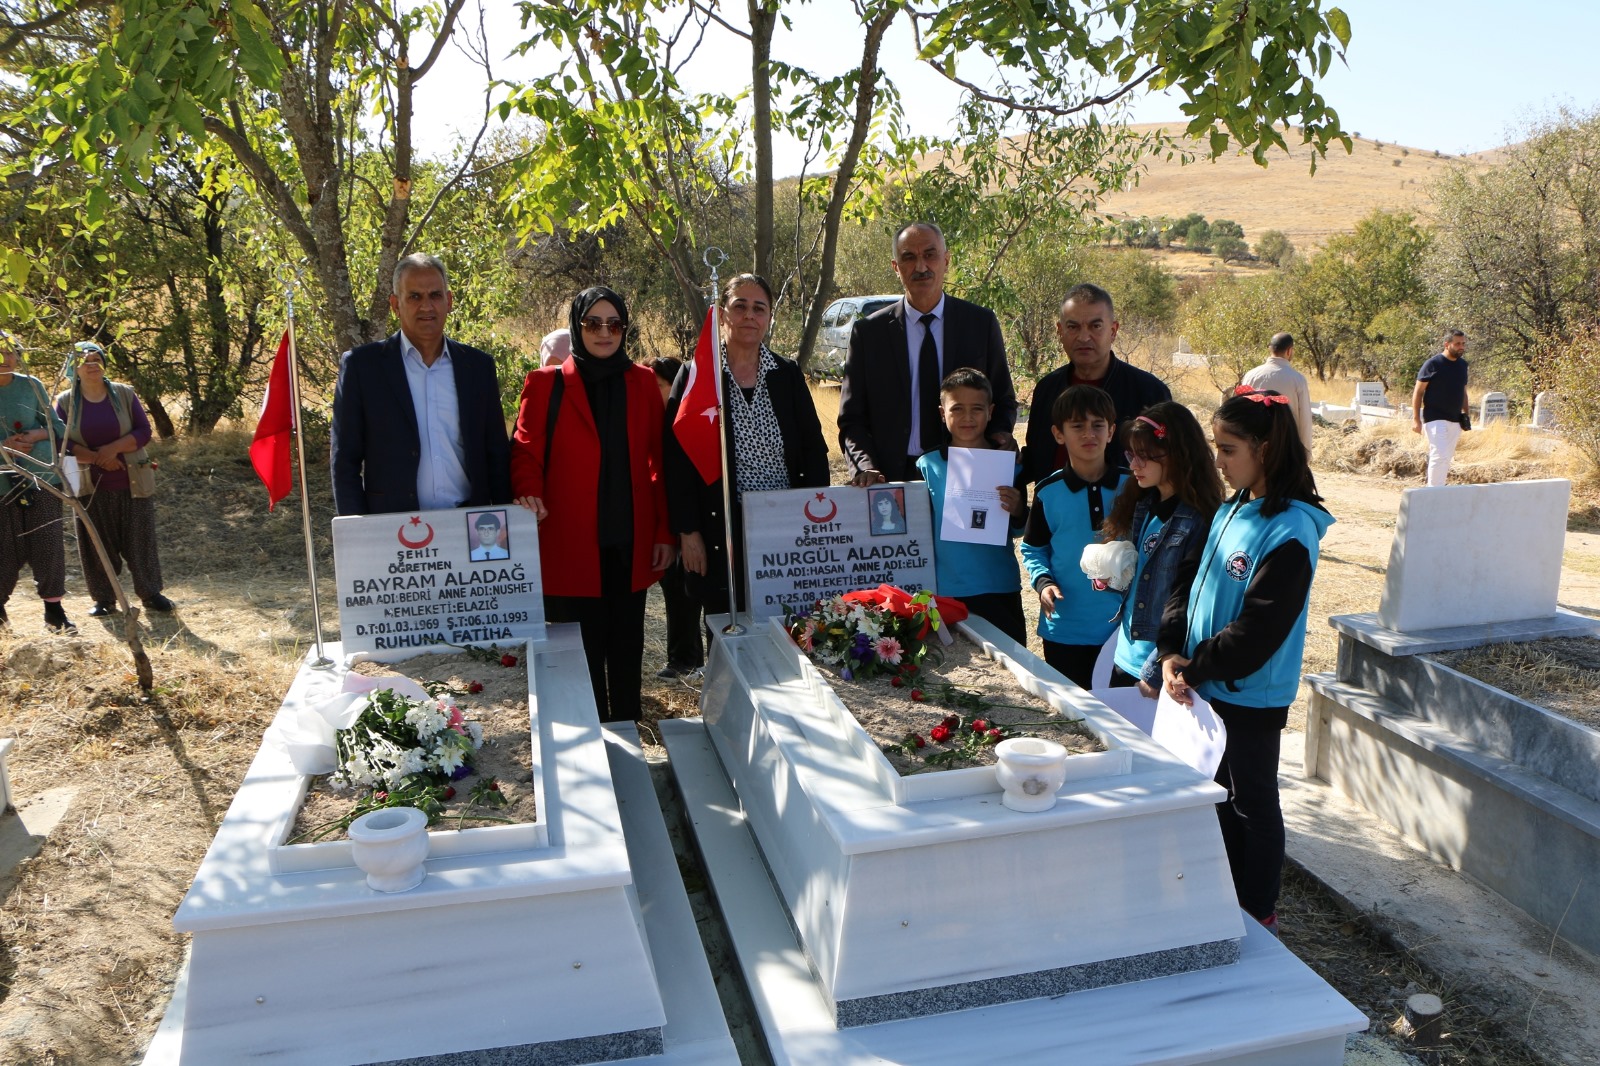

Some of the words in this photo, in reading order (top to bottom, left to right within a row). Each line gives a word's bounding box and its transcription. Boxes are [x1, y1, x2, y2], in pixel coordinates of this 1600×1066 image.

[803, 523, 842, 535] ŞEHİT
[795, 535, 854, 547] ÖĞRETMEN
[397, 548, 439, 561] ŞEHİT
[762, 547, 840, 567] NURGÜL
[847, 540, 920, 561] ALADAĞ
[388, 560, 452, 574] ÖĞRETMEN
[755, 569, 784, 580] BABA
[786, 564, 845, 578] ADI:HASAN
[852, 561, 880, 573] ANNE
[883, 557, 928, 570] ADI:ELİF
[353, 574, 436, 594] BAYRAM
[444, 563, 525, 587] ALADAĞ
[793, 571, 894, 590] MEMLEKETİ:ELAZIĞ
[345, 594, 372, 607] BABA
[376, 589, 432, 605] ADI:BEDRİ
[438, 587, 466, 600] ANNE
[470, 582, 534, 598] ADI:NUSHET
[384, 597, 499, 618] MEMLEKETİ:ELAZIĞ
[356, 619, 440, 636] D.T:01.03.1969
[375, 632, 444, 650] RUHUNA
